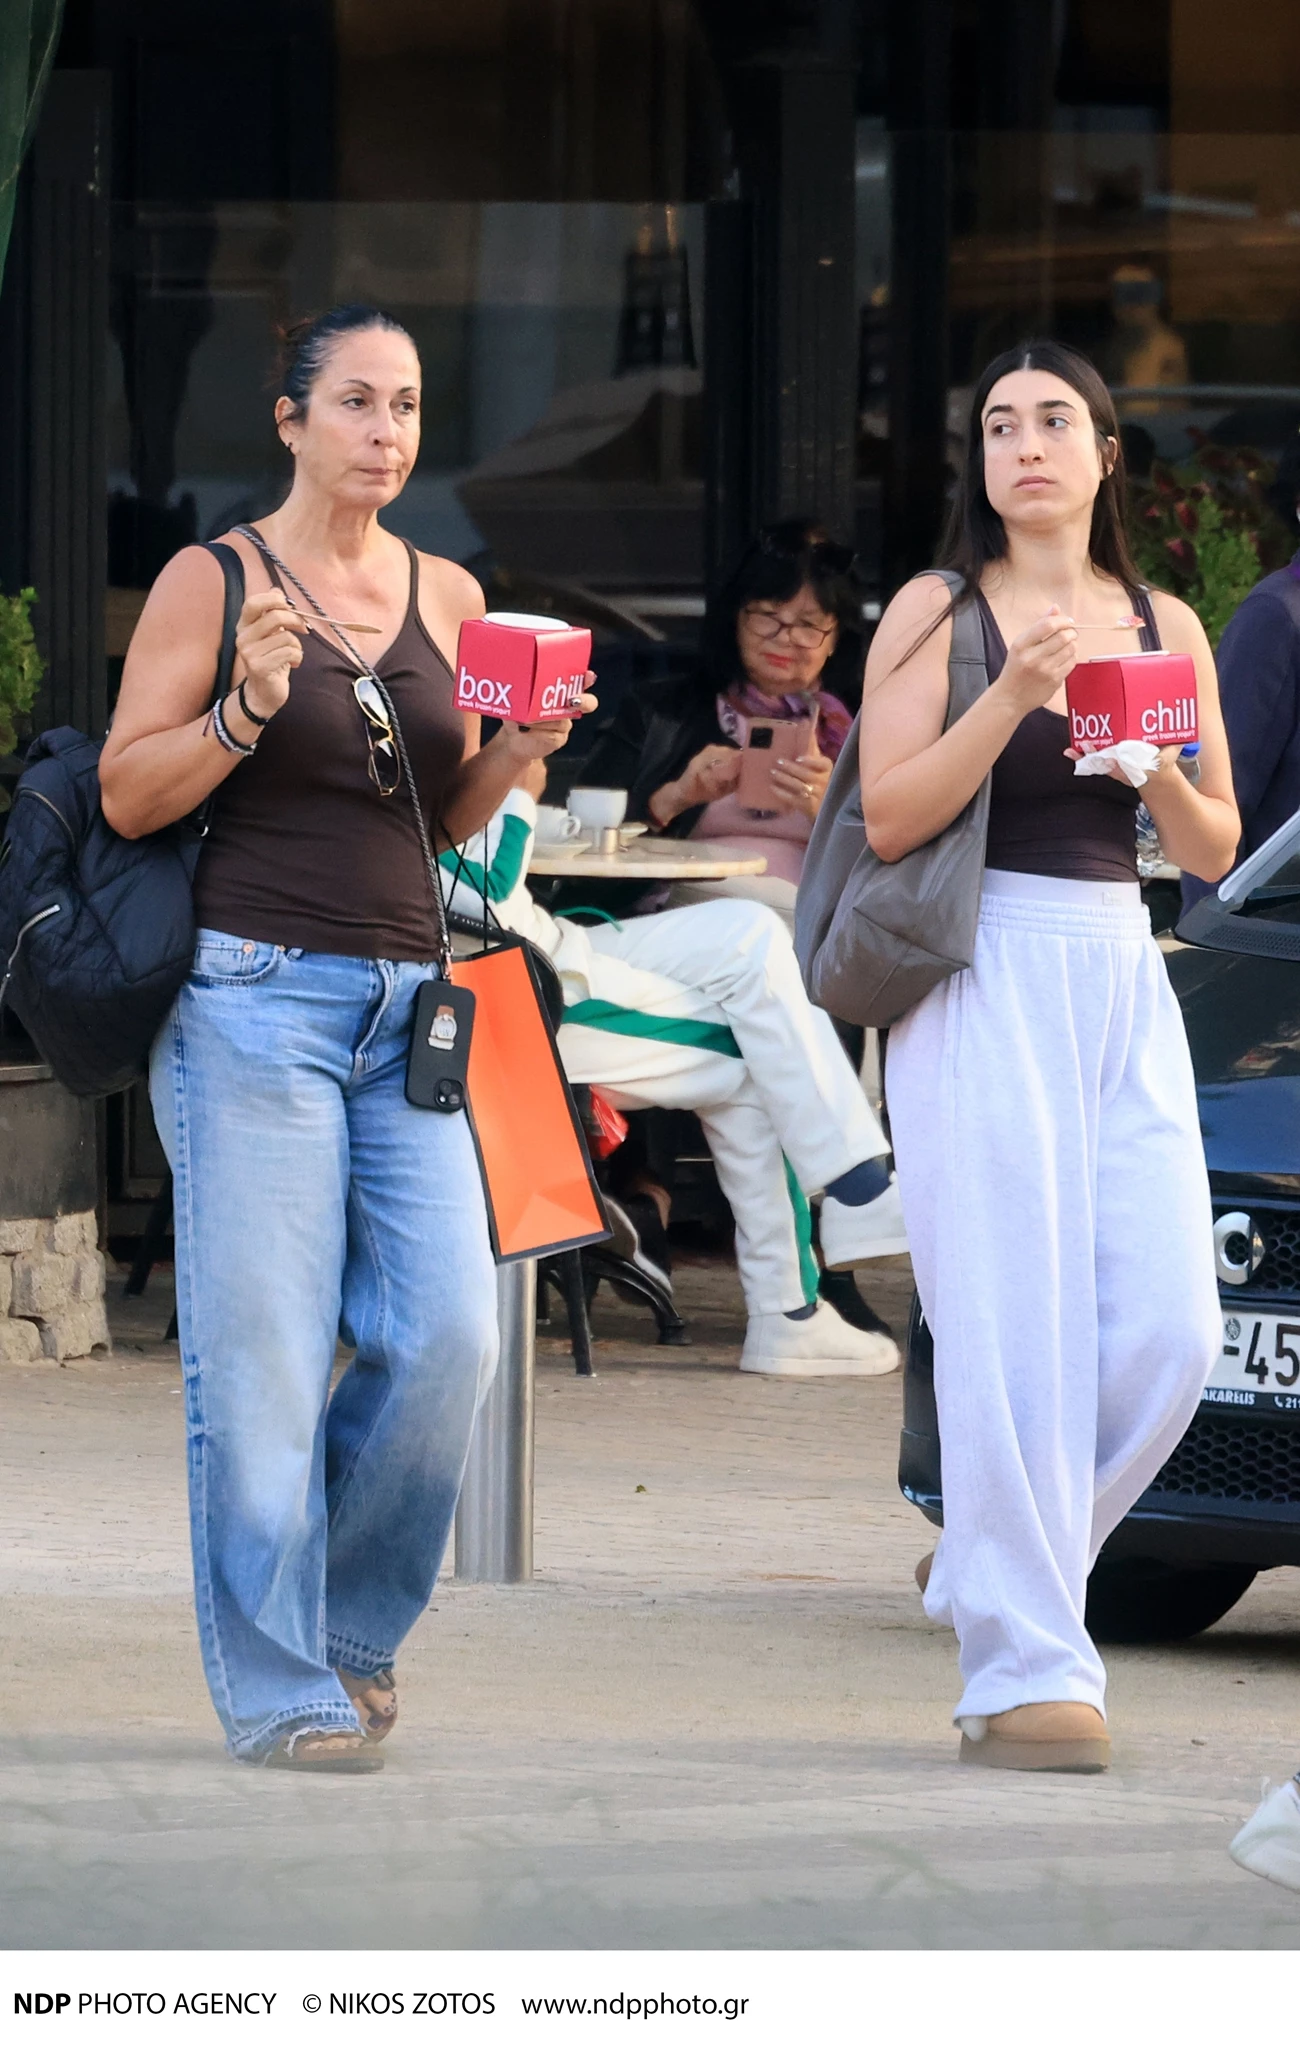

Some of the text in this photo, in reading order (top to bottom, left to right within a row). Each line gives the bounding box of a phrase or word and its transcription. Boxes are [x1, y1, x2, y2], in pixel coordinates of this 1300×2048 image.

[459, 666, 513, 708] box
[541, 674, 584, 709] chill
[1071, 708, 1113, 739] box
[1141, 697, 1196, 734] chill
